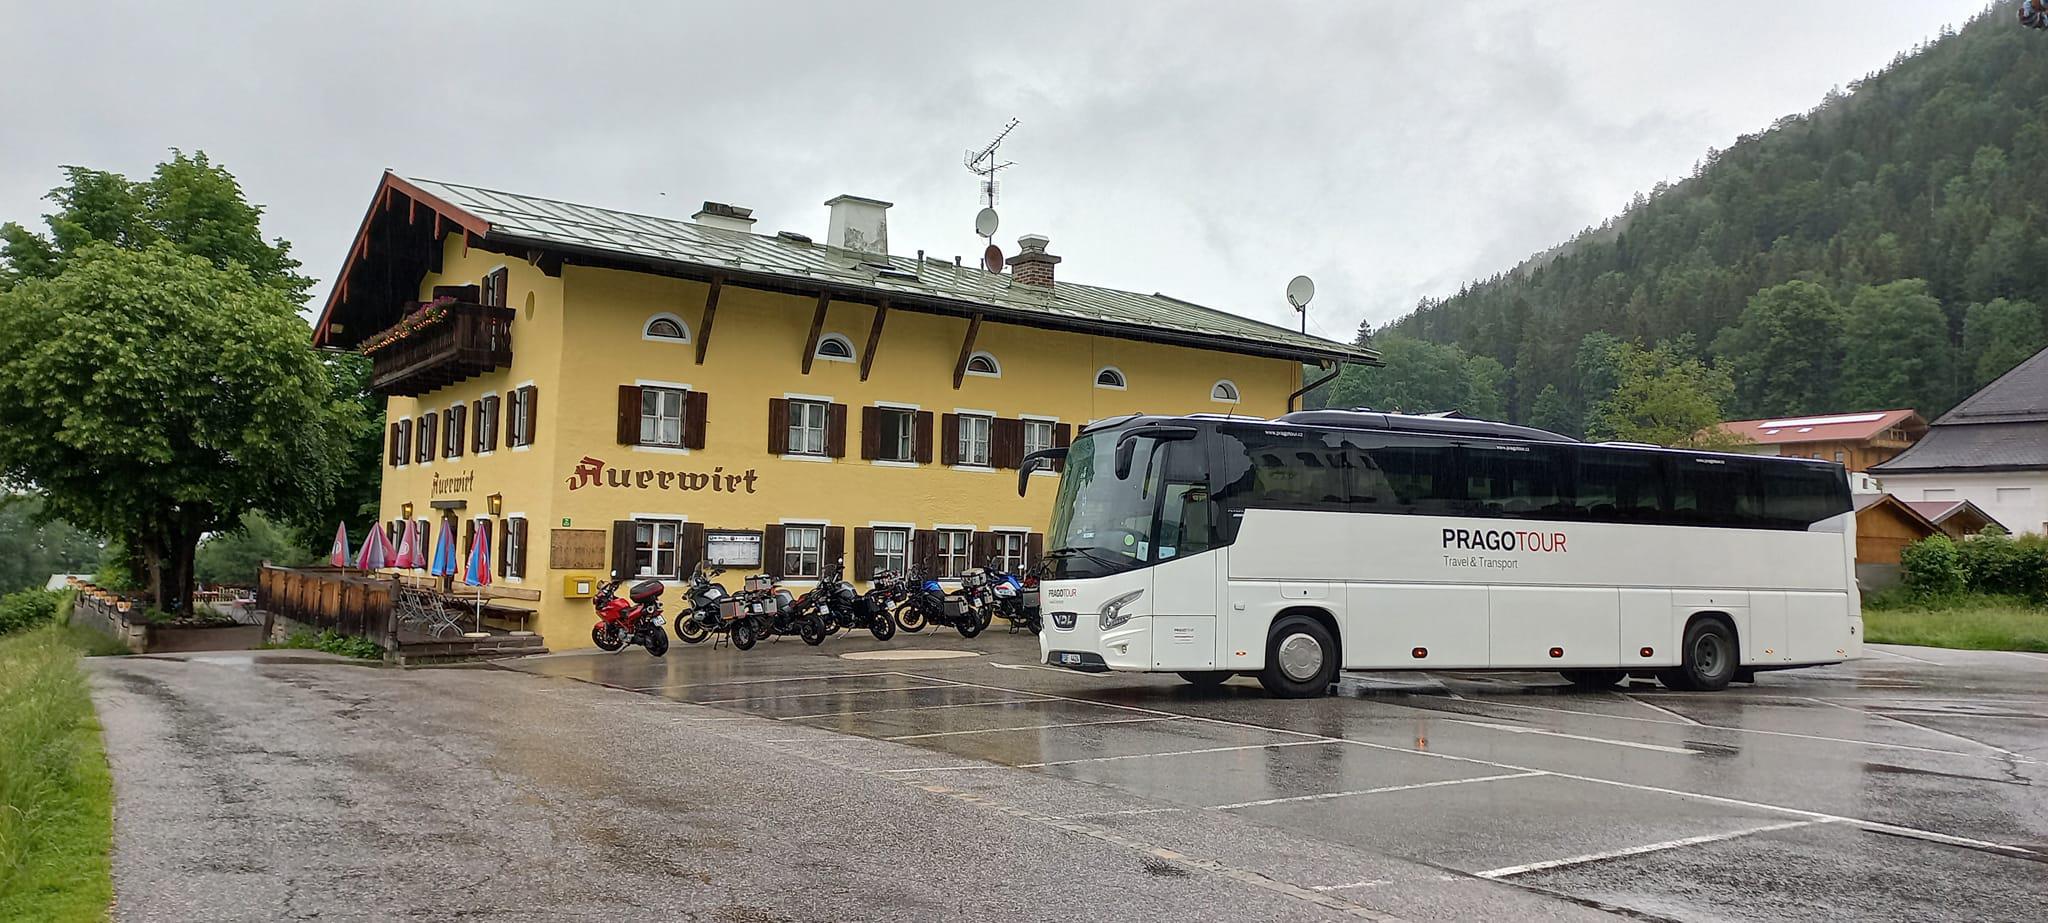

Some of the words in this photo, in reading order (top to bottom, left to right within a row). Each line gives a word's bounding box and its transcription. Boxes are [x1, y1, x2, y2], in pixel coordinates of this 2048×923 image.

[431, 469, 474, 498] Auerwirt
[565, 456, 758, 494] Auerwirt
[1442, 528, 1567, 552] PRAGOTOUR
[1443, 555, 1469, 567] Travel
[1469, 556, 1477, 567] &
[1479, 557, 1518, 571] Transport
[1055, 615, 1073, 626] VDL
